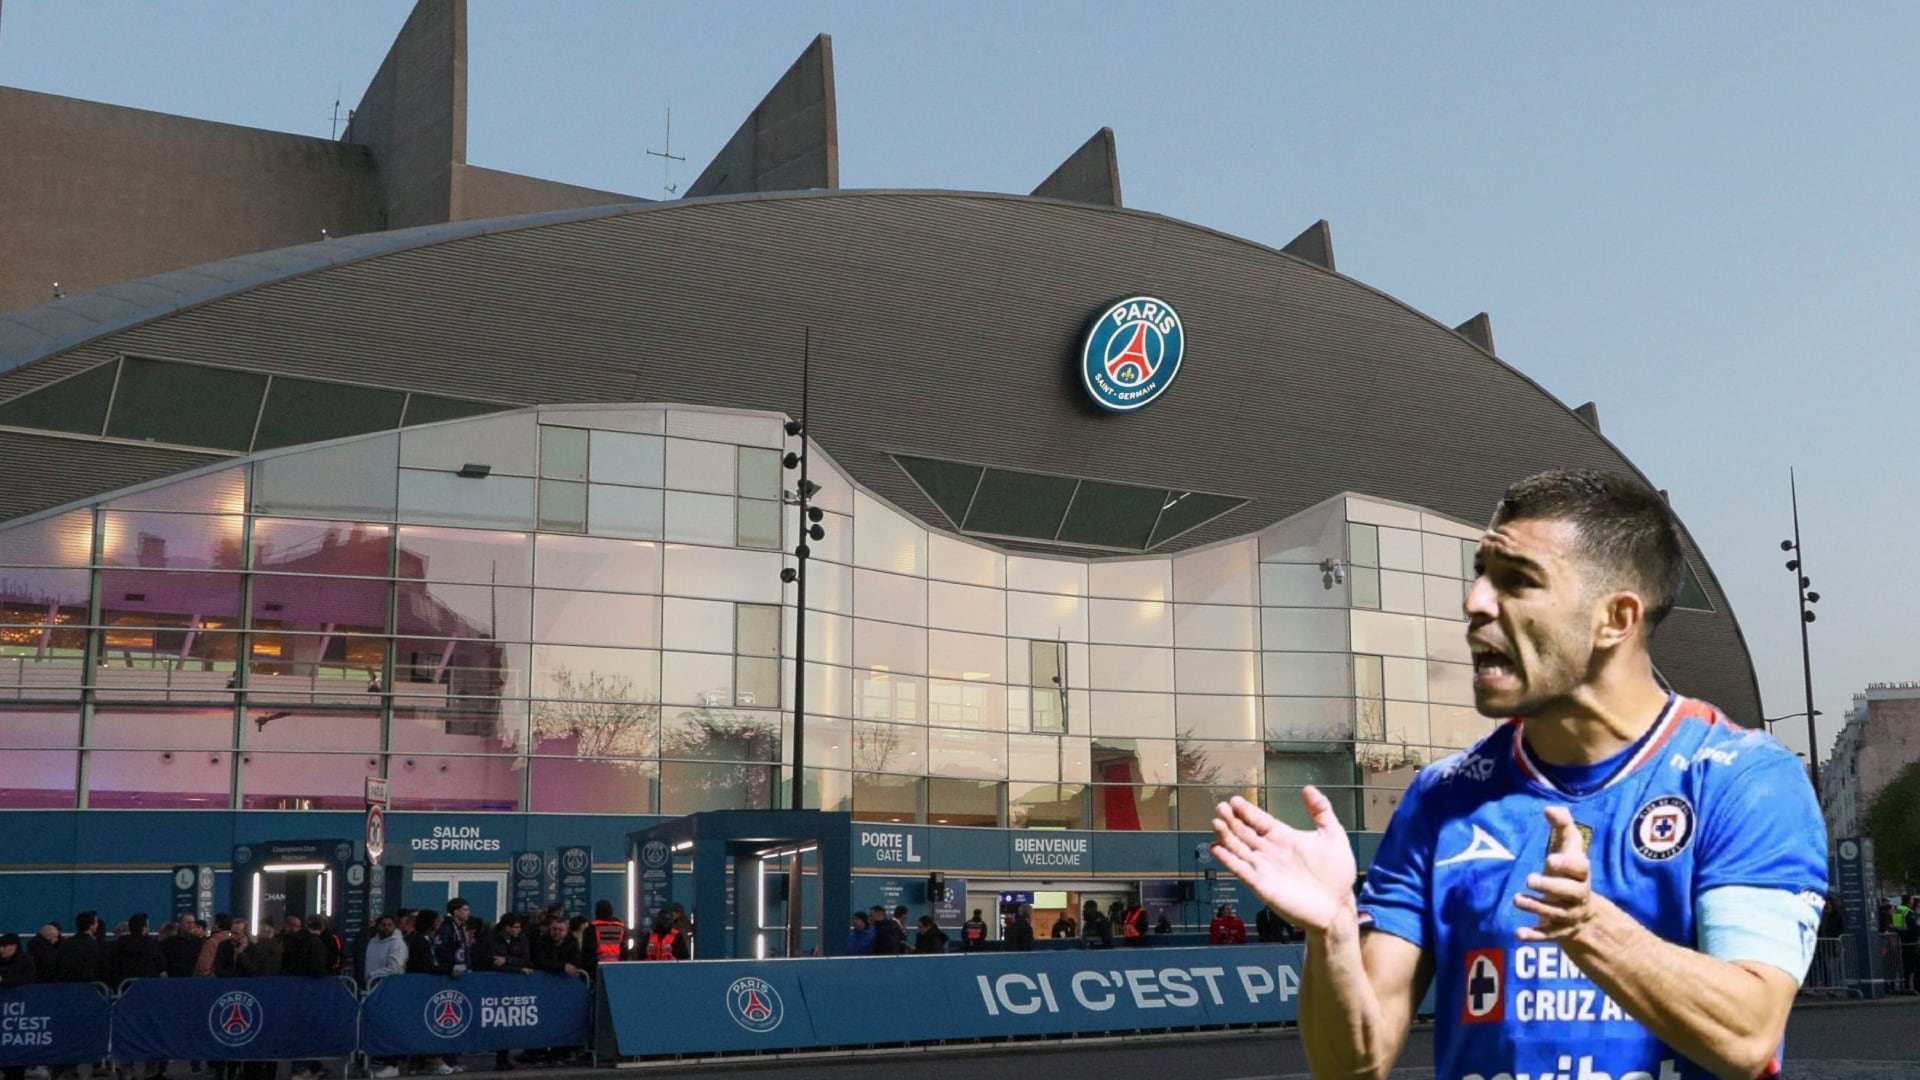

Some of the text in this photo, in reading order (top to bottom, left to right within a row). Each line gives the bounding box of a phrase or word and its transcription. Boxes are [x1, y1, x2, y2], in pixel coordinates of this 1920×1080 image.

[1112, 303, 1175, 334] PARIS
[1095, 373, 1156, 400] SAINT GERMAIN
[433, 826, 480, 838] SALON
[411, 839, 501, 851] DES PRINCES
[861, 832, 921, 862] PORTE L
[1015, 838, 1088, 853] BIENVENUE
[1844, 845, 1853, 856] L
[876, 849, 903, 862] GATE
[1023, 854, 1080, 866] WELCOME
[181, 873, 190, 885] L
[353, 868, 361, 881] L
[733, 980, 769, 993] PARIS
[977, 973, 1059, 1015] ICI
[1071, 966, 1225, 1011] C'EST
[219, 994, 255, 1007] PARIS
[433, 992, 463, 1004] PARIS
[481, 996, 537, 1006] ICI C'EST
[3, 1002, 25, 1016] ICI
[1516, 989, 1635, 1022] CRUZ A
[2, 1016, 51, 1030] C'EST
[481, 1006, 539, 1028] PARIS
[2, 1032, 53, 1046] PARIS
